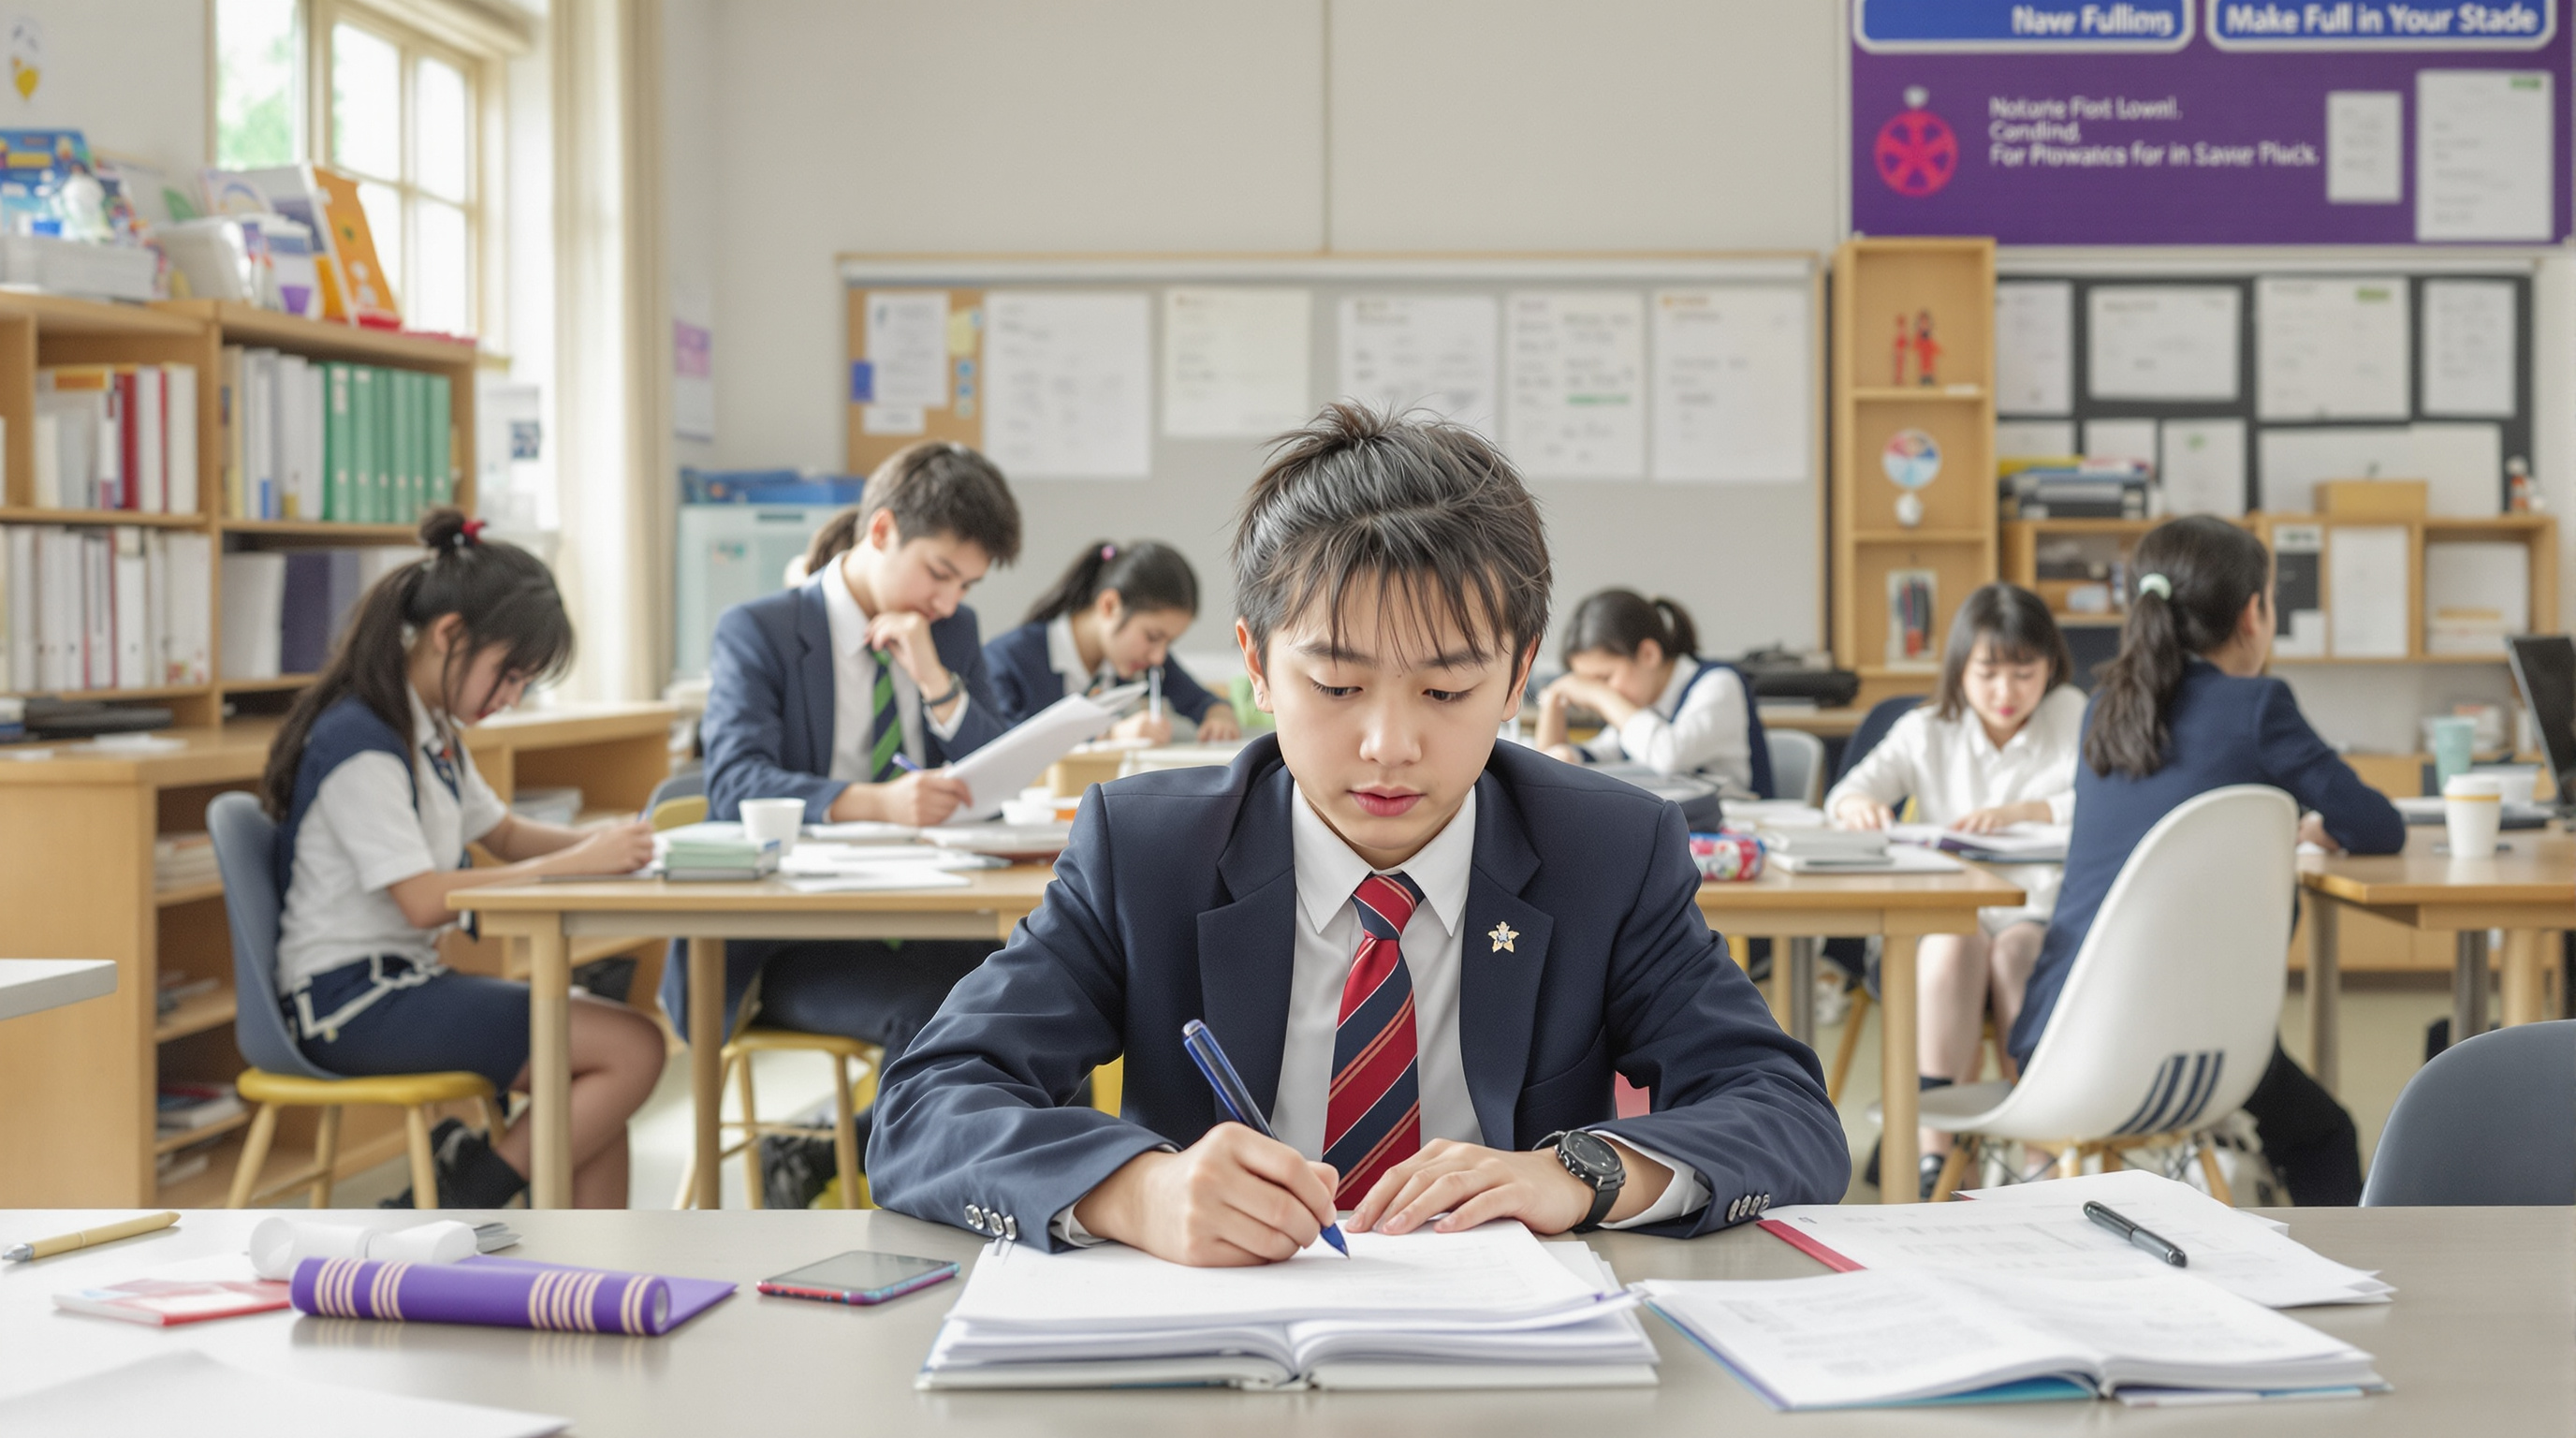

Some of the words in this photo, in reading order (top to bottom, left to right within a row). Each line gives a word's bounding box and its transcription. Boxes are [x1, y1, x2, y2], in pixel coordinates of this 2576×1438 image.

[2227, 5, 2299, 33] Make
[2304, 5, 2353, 33] Full
[2357, 5, 2383, 33] in
[2388, 5, 2452, 33] Your
